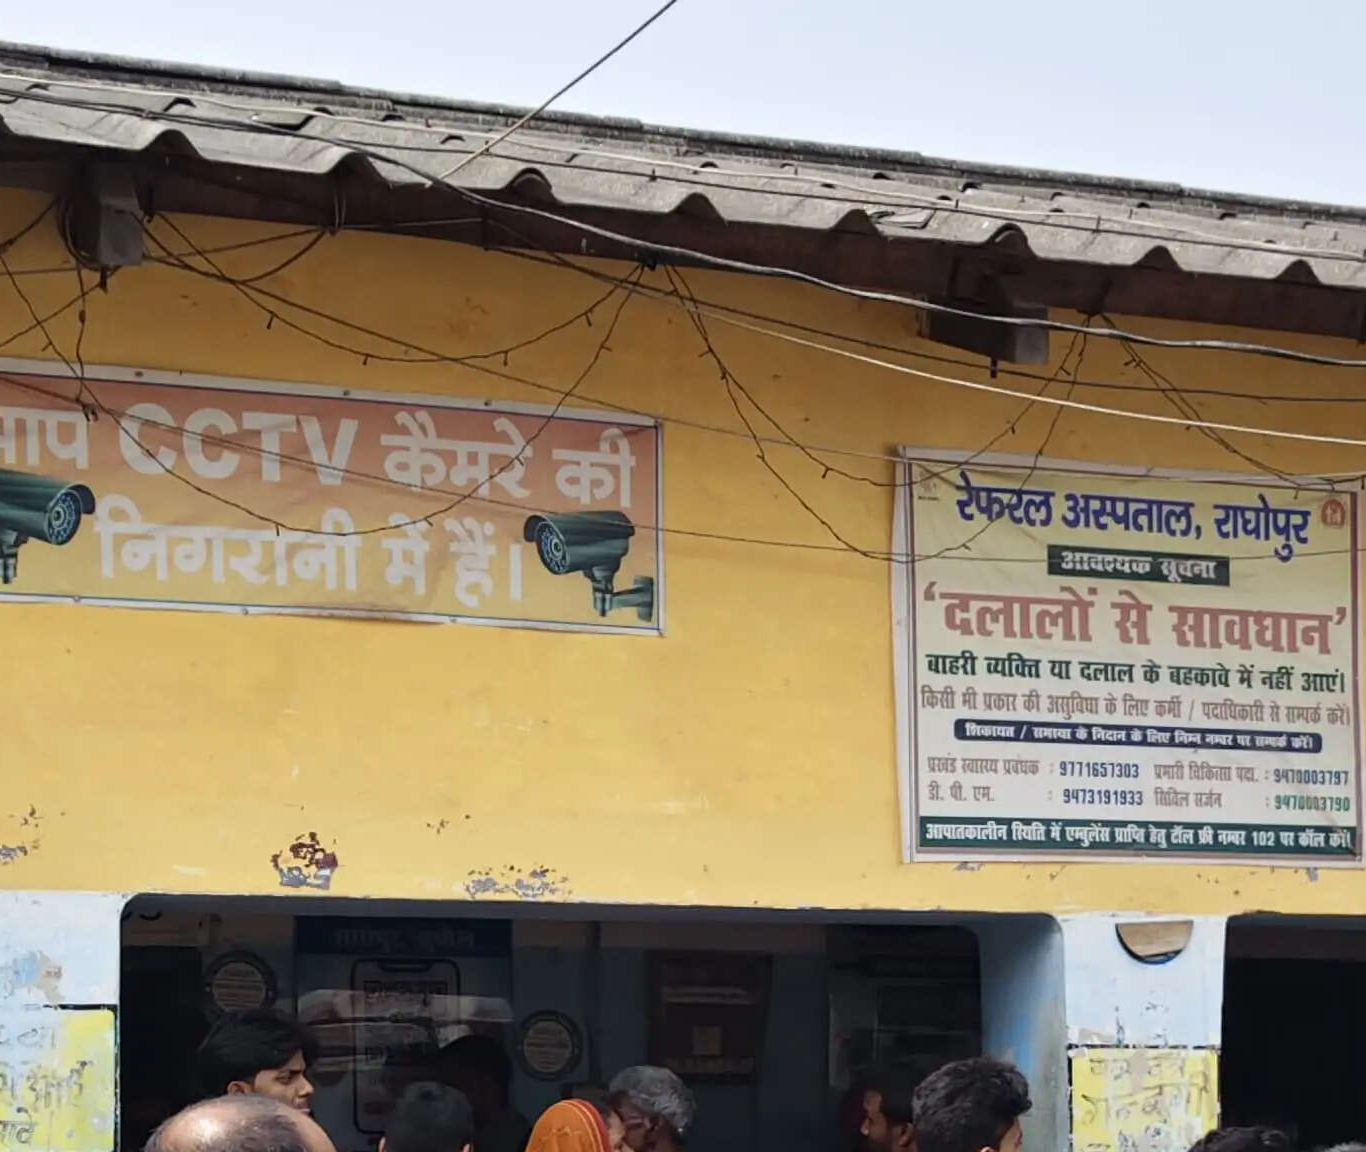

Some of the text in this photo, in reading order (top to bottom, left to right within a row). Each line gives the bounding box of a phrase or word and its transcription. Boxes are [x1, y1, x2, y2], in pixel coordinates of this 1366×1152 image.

[119, 403, 359, 486] CCTV
[380, 410, 532, 498] कैमरे
[552, 427, 635, 507] की
[956, 471, 1311, 562] रेफरल अस्पताल, राघोपुर
[94, 493, 360, 592] निगरानी
[383, 511, 430, 595] में
[1061, 551, 1217, 582] आवश्यक सूचना
[1110, 590, 1152, 645] से
[984, 652, 1041, 678] व्यक्ति
[1048, 660, 1071, 679] या
[1078, 660, 1134, 683] दलाल
[1141, 659, 1161, 684] के
[1168, 662, 1230, 687] बहकावे
[1237, 664, 1255, 689] में
[1260, 666, 1295, 690] नहीं
[921, 685, 955, 709] किसी
[962, 686, 977, 709] भी
[983, 692, 1017, 712] प्रकार
[1022, 689, 1040, 713] की
[1104, 693, 1117, 715] के
[1123, 693, 1149, 717] लिए
[1269, 700, 1281, 723] से
[1251, 831, 1275, 847] 102
